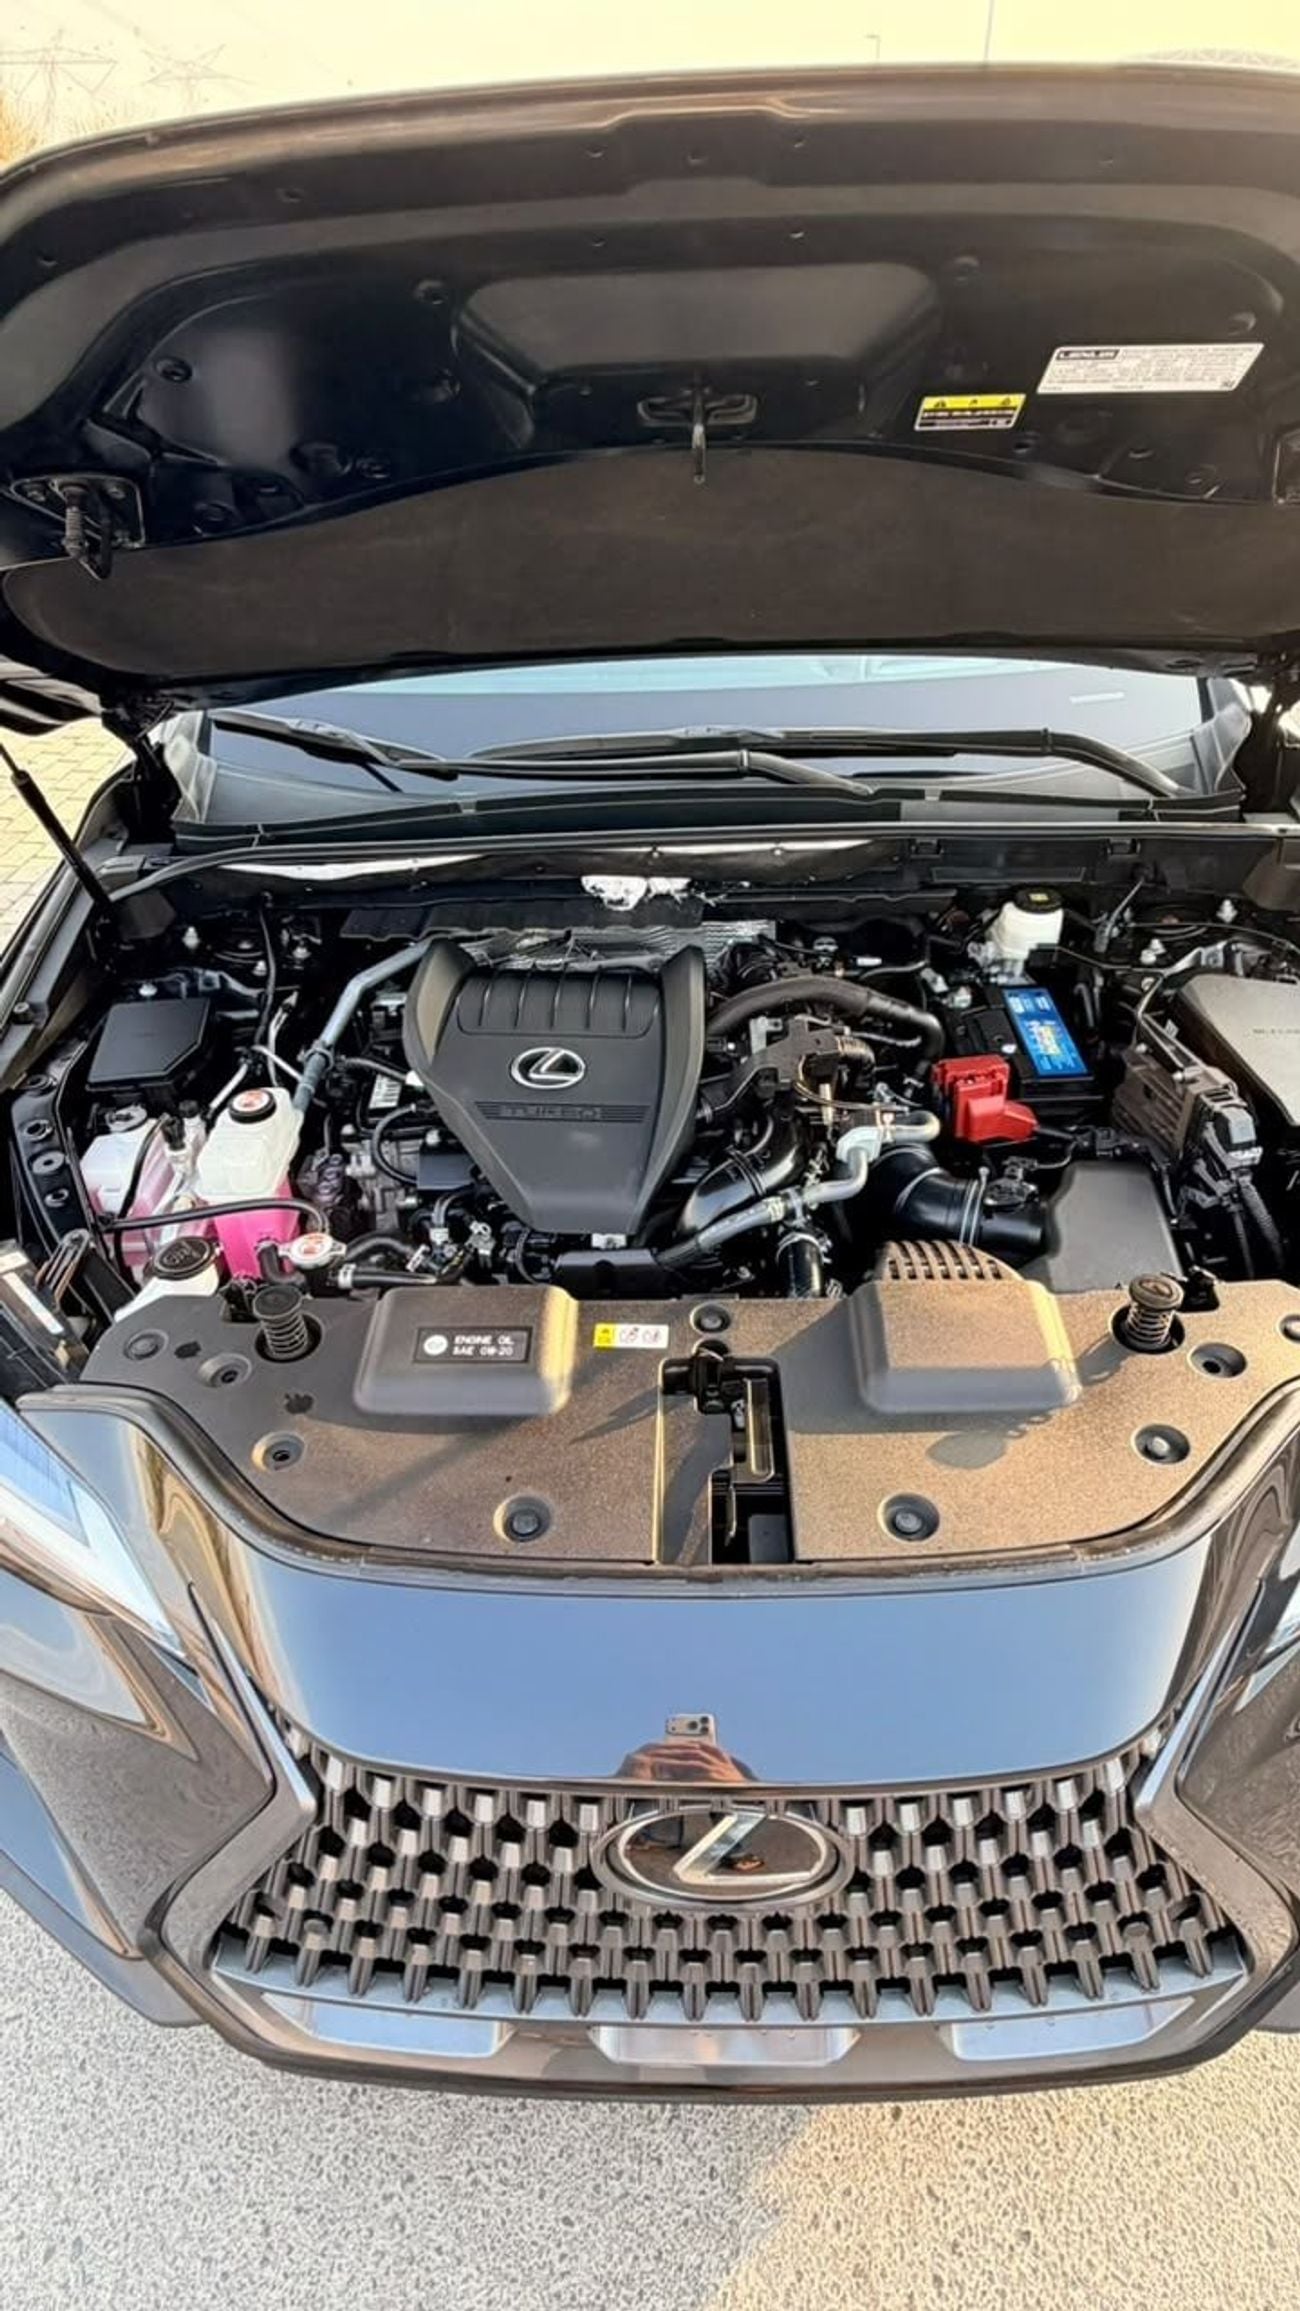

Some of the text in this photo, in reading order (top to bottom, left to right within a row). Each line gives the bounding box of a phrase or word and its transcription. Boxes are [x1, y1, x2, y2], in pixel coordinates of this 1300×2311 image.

[454, 1335, 515, 1345] ENGINE OIL
[452, 1346, 475, 1356] SAE
